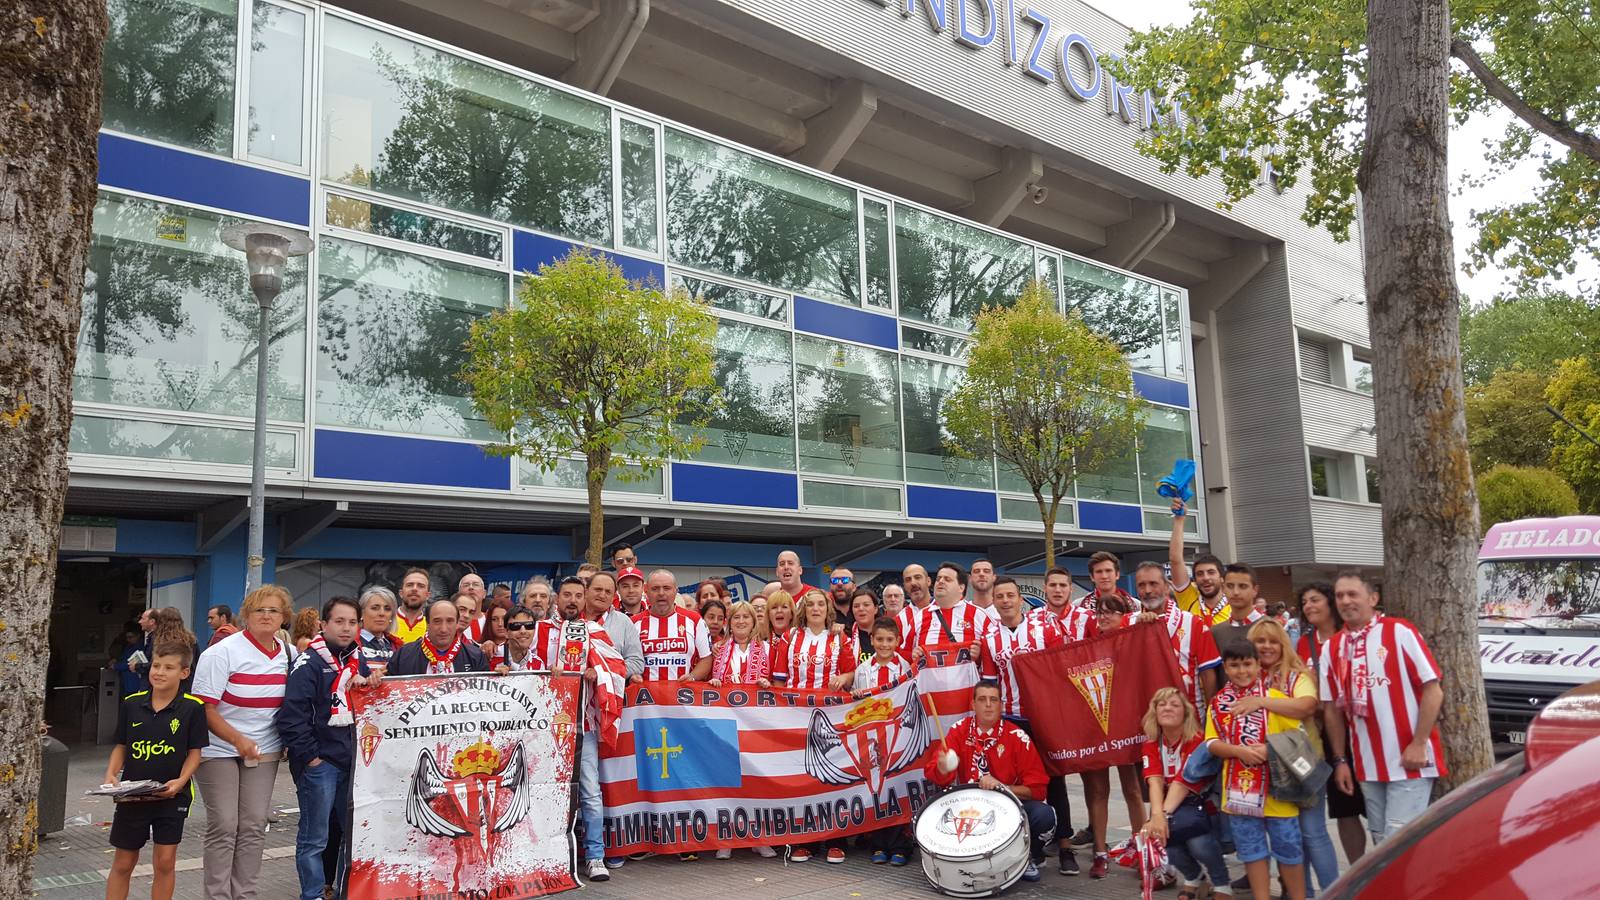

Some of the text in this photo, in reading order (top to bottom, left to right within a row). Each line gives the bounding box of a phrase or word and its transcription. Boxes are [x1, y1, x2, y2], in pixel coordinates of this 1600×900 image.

[431, 701, 511, 716] LA REGENCE
[437, 678, 538, 719] SPORTINGUISTA
[384, 718, 549, 740] SENTIMIENTO ROJIBLANCO
[131, 739, 176, 761] gijón
[1080, 746, 1096, 758] por
[1098, 741, 1108, 753] el
[602, 808, 708, 849] TIMIENTO
[716, 794, 866, 840] ROJIBLANCO
[872, 786, 903, 821] LA
